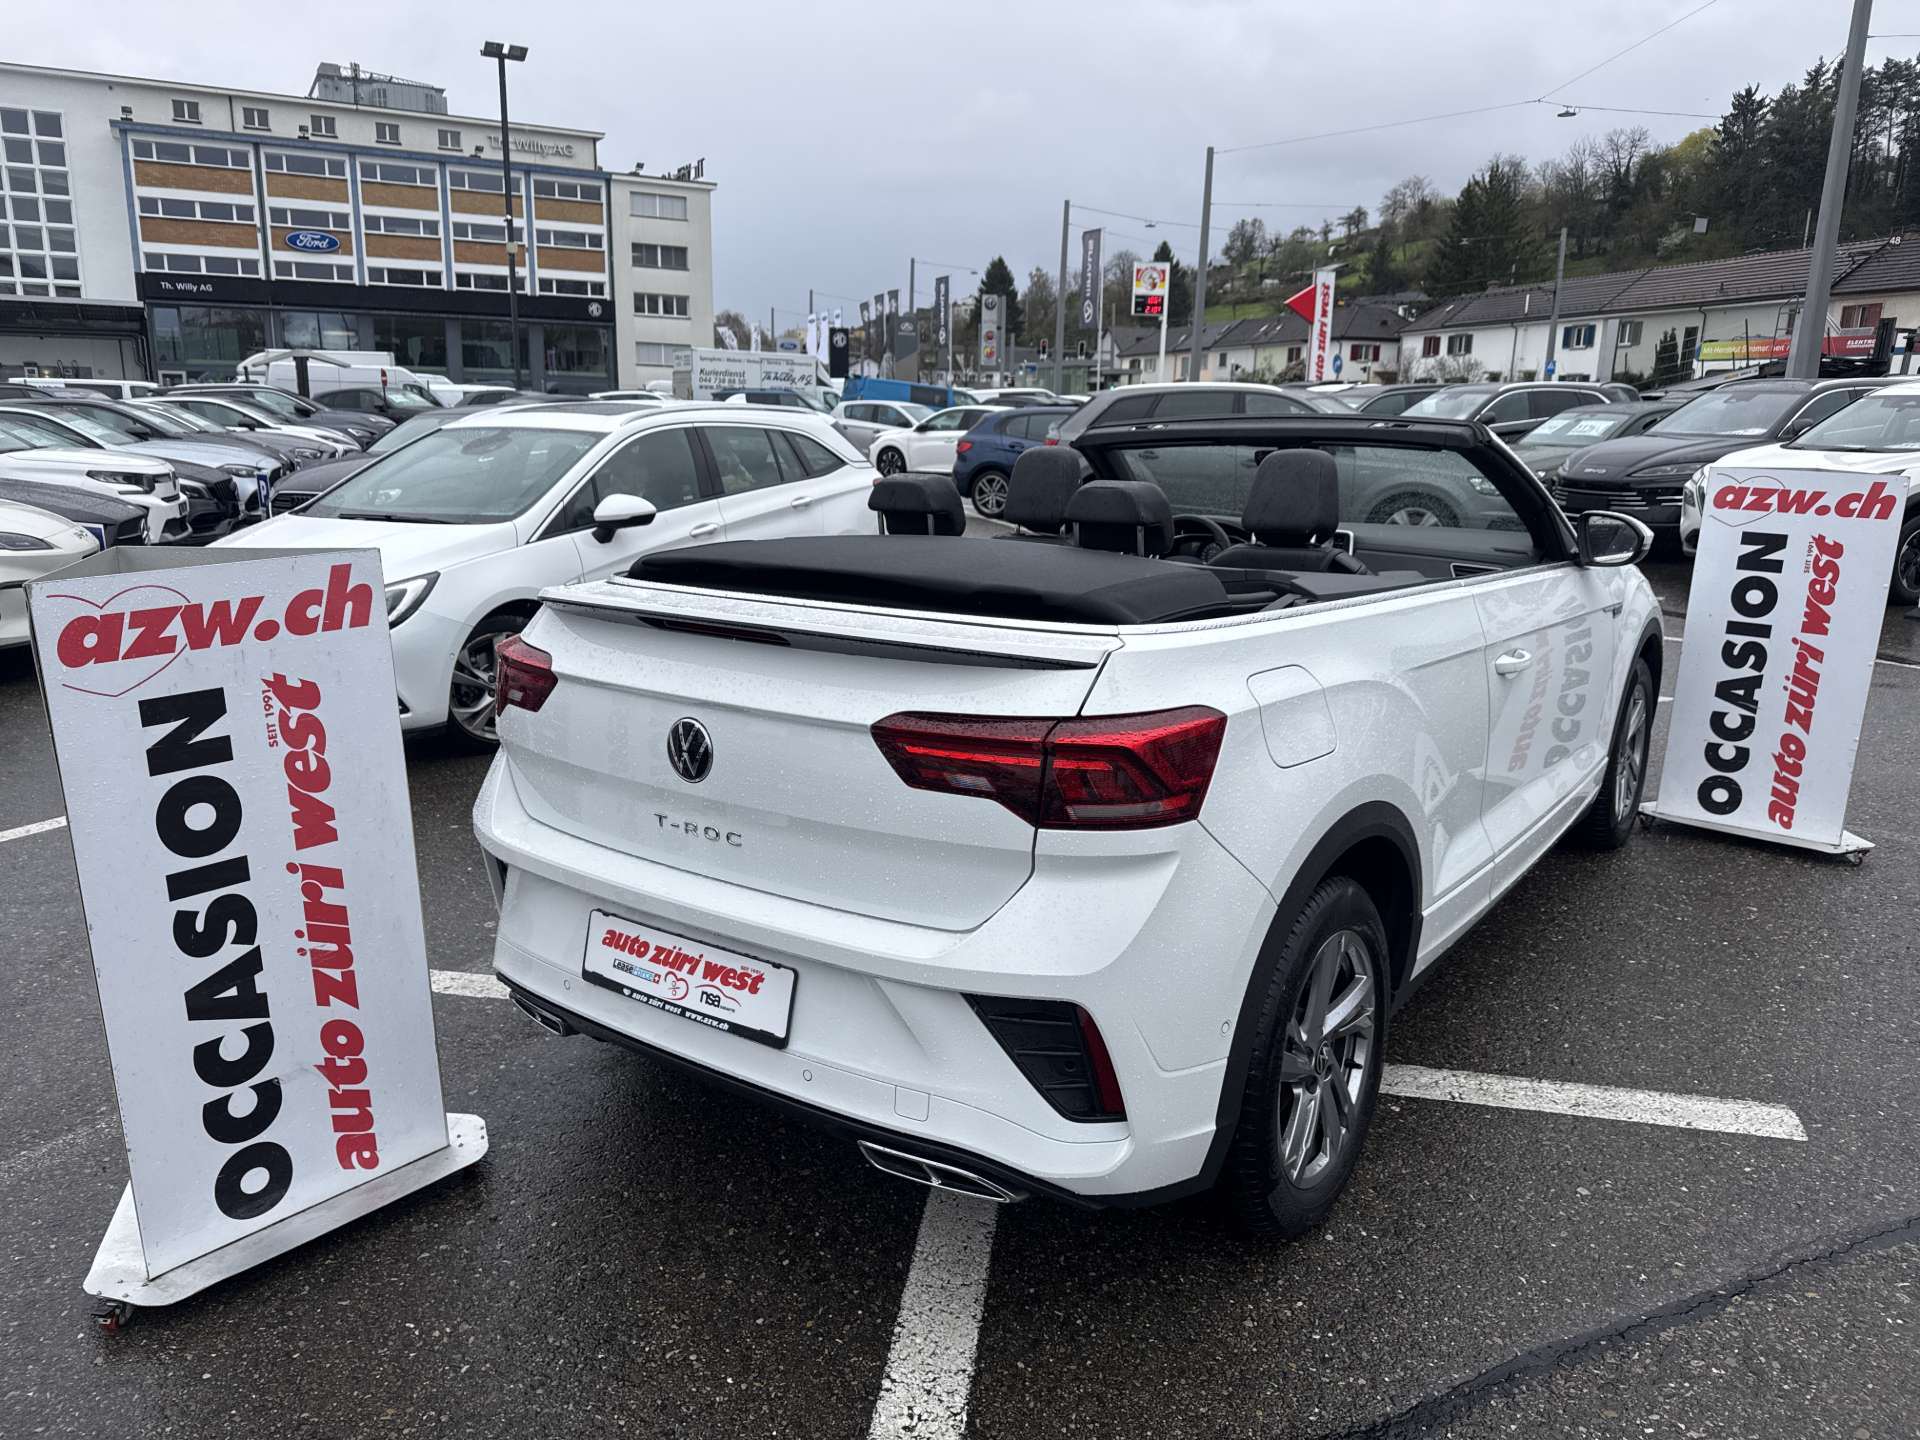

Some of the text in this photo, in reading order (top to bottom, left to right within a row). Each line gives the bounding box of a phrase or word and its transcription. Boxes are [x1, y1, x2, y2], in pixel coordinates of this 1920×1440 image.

[514, 135, 550, 157] Willy
[553, 143, 575, 156] AG
[296, 233, 329, 249] Ford
[1889, 236, 1901, 245] 48
[160, 281, 213, 292] Th. Willy AG
[833, 332, 847, 348] MG
[699, 368, 746, 378] Kurierdienst
[1712, 481, 1898, 520] azw.ch
[1804, 558, 1812, 574] SEIT
[57, 563, 374, 668] azw.ch
[1697, 530, 1789, 815] OCCASION
[1768, 533, 1845, 830] auto züri west
[262, 688, 279, 748] SEIT 1991
[653, 813, 742, 847] T-ROC
[261, 672, 379, 1170] auto züri west
[138, 686, 293, 1220] OCCASION
[601, 928, 767, 995] auto züri west
[631, 991, 649, 1003] auto
[664, 1001, 682, 1015] west
[700, 990, 721, 1009] nsa
